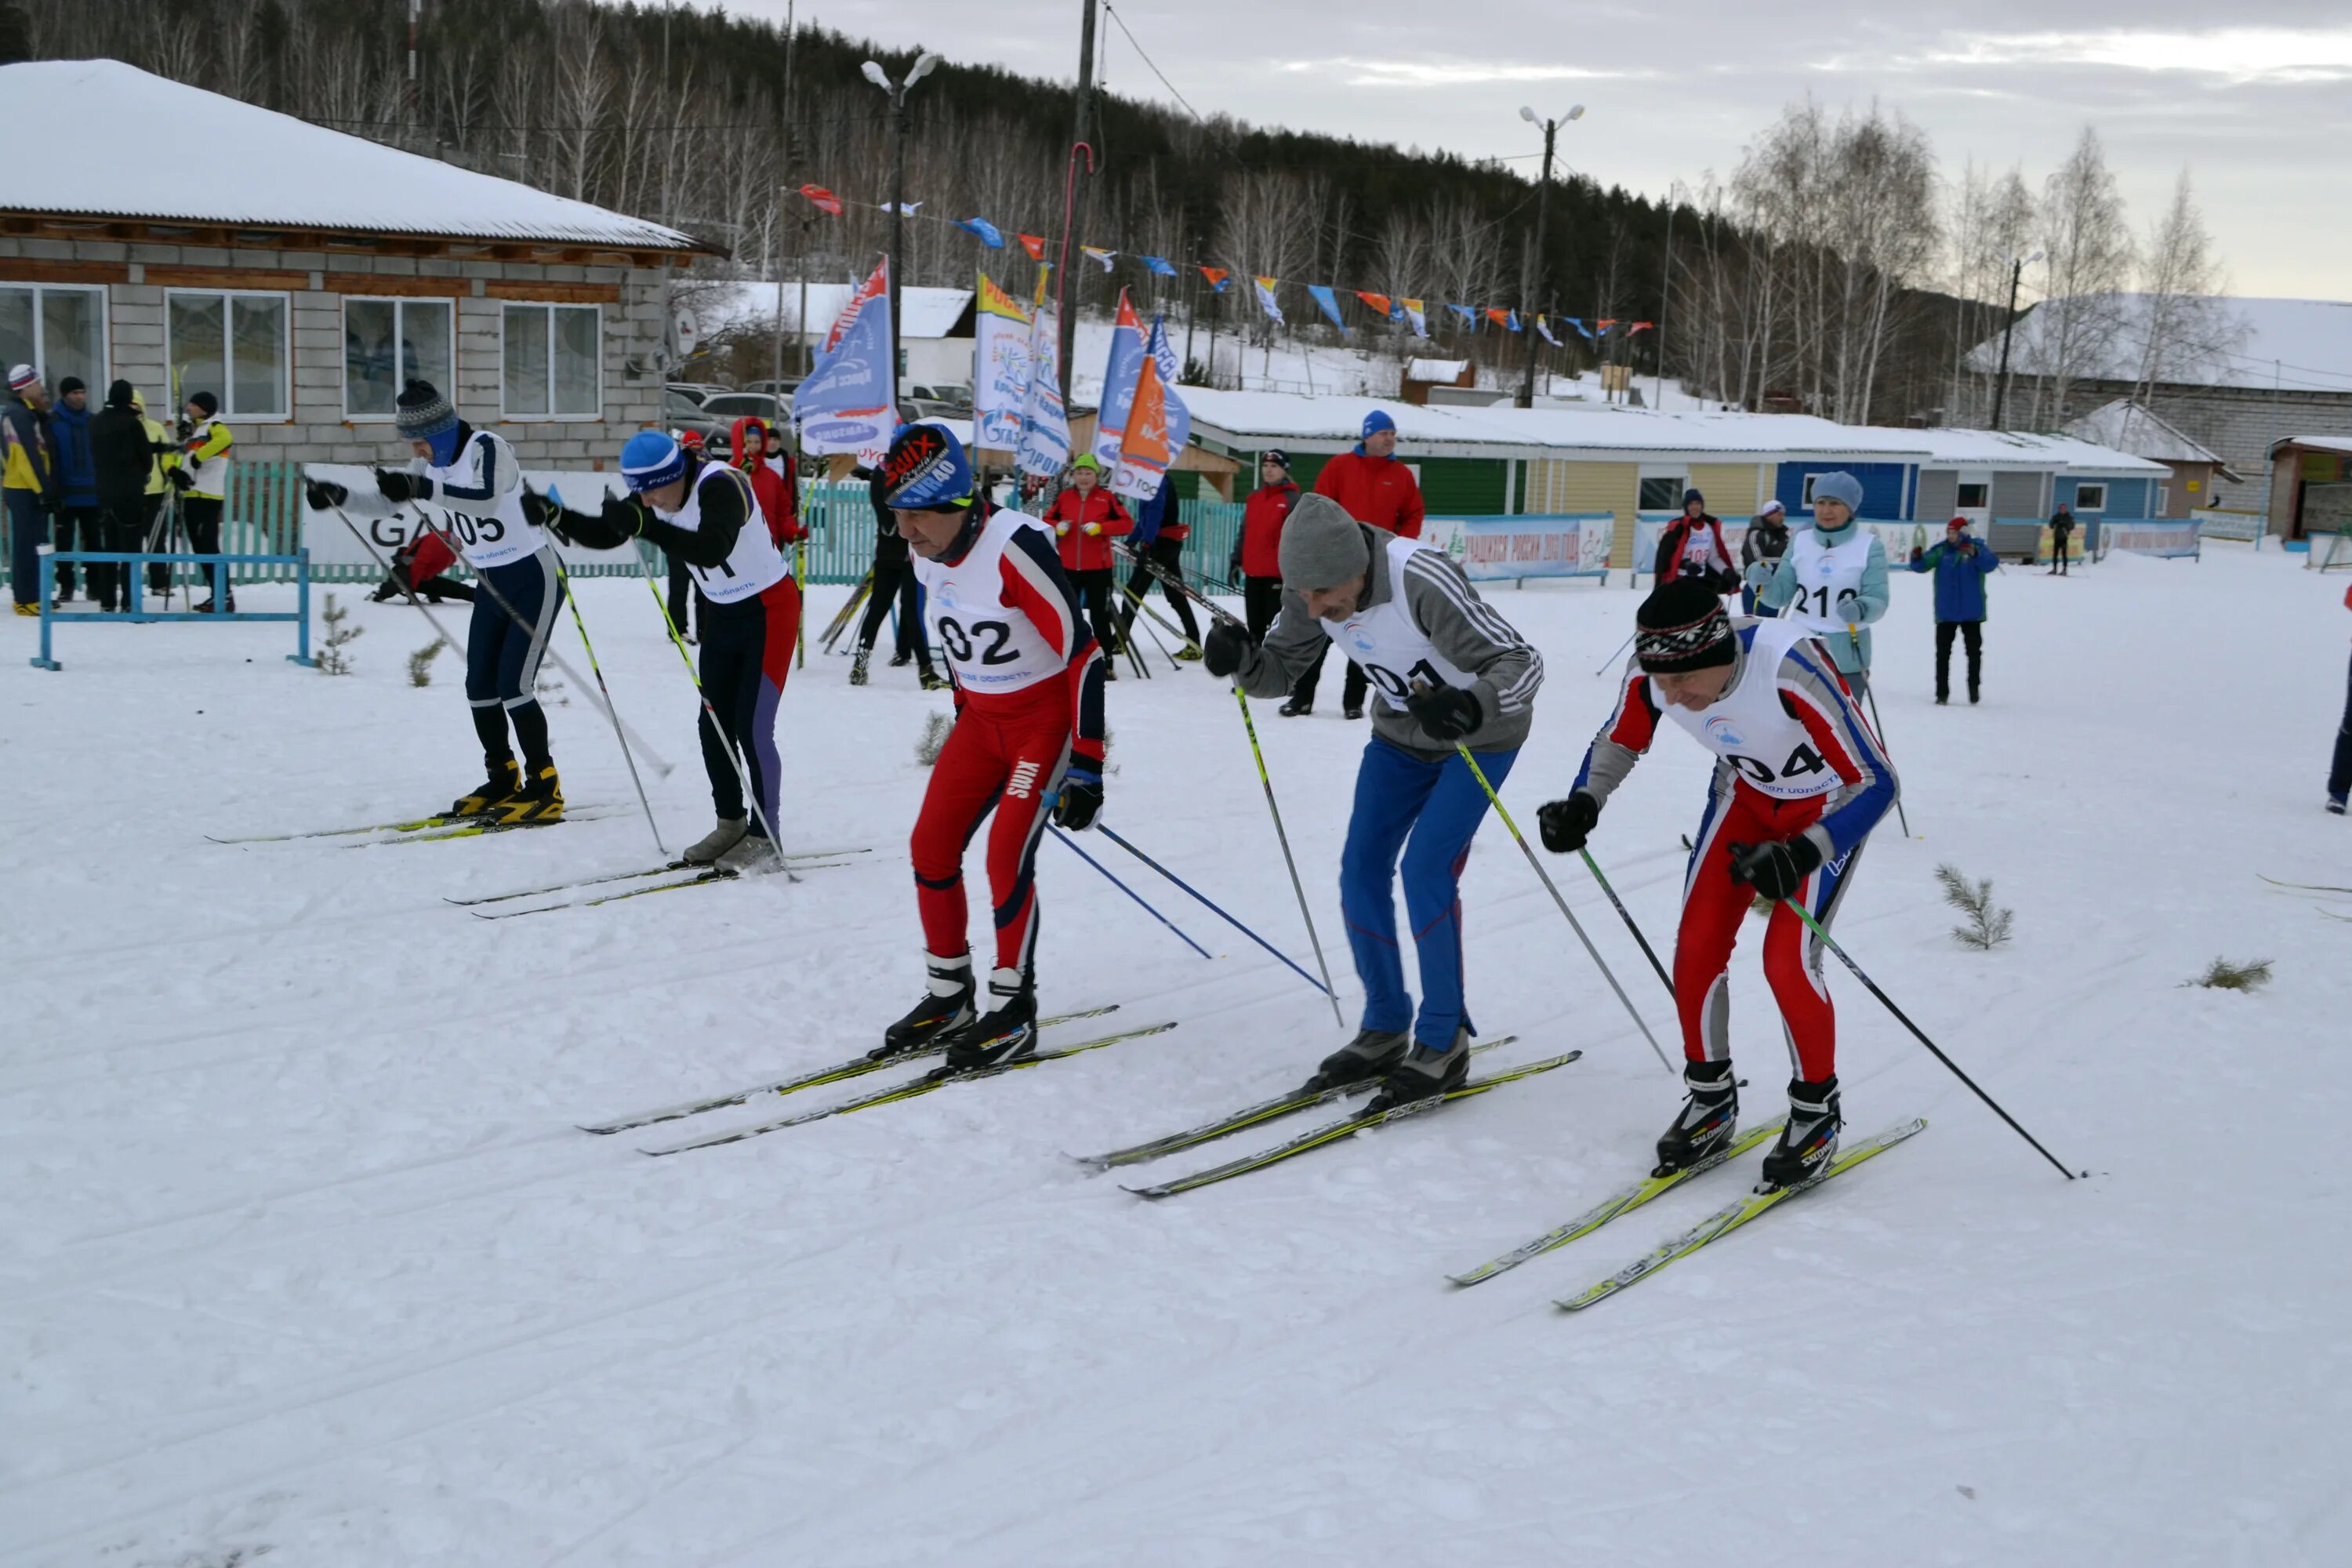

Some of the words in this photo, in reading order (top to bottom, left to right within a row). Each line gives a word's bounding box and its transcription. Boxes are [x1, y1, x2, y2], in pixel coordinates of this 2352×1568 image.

[1512, 533, 1542, 562] РОССИИ
[938, 615, 1021, 666] 02
[1726, 742, 1827, 783] 04
[1382, 1093, 1446, 1123] FISCHER
[1690, 1116, 1732, 1148] SALOMON
